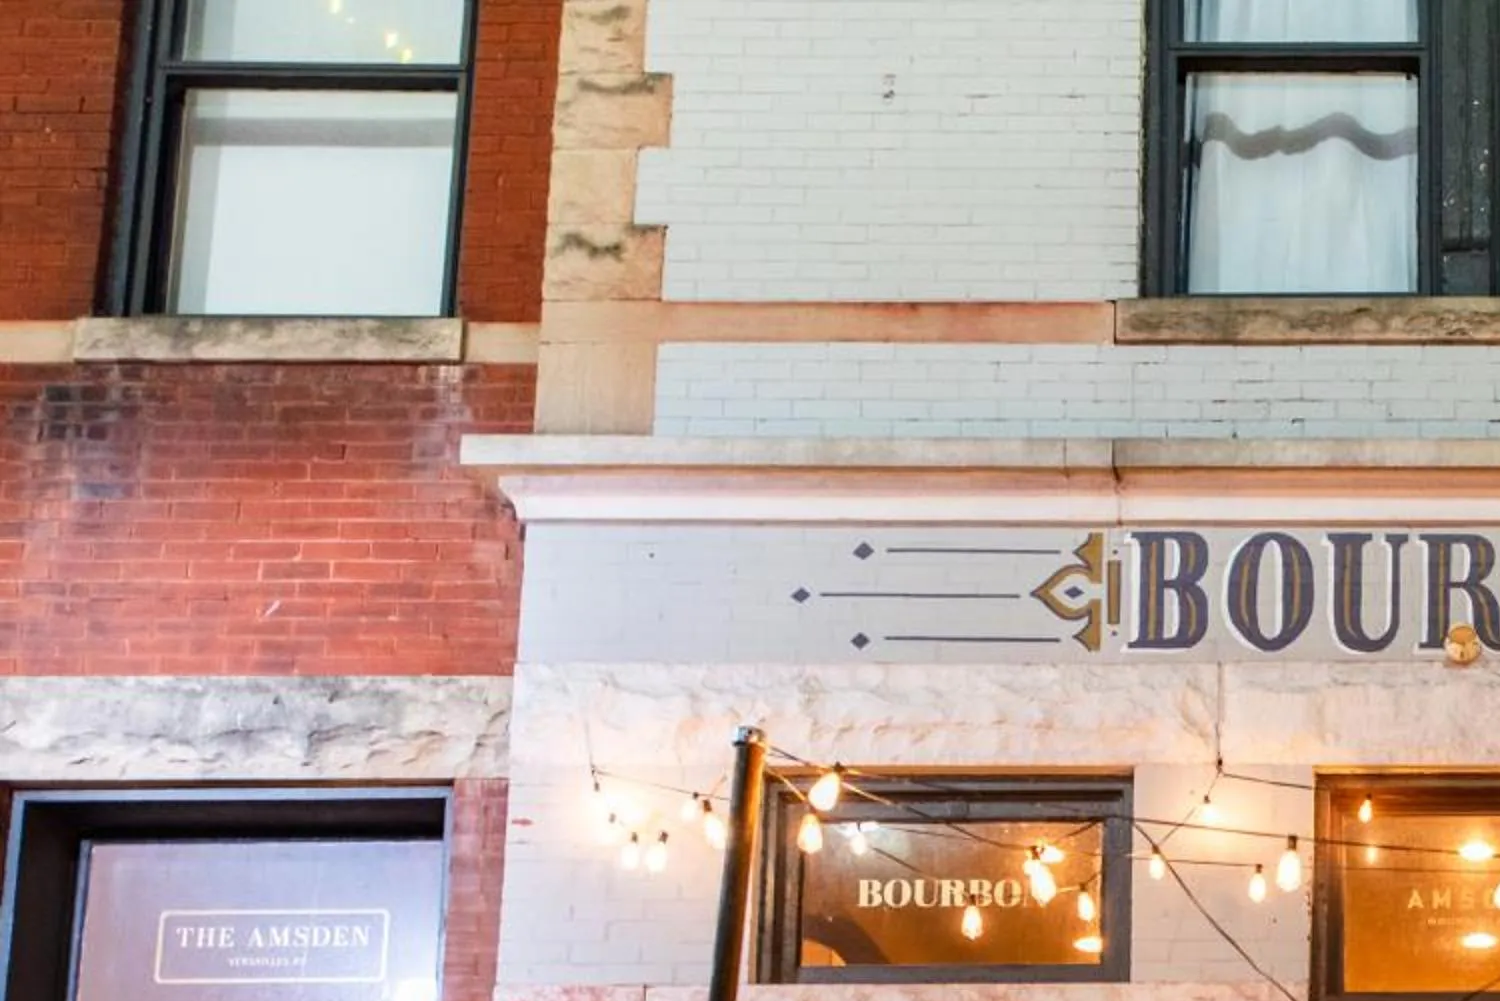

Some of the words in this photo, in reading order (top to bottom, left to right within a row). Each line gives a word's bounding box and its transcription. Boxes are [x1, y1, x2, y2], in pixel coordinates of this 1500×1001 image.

[857, 878, 1056, 908] BOURBO
[176, 925, 235, 948] THE
[248, 924, 371, 948] AMSDEN
